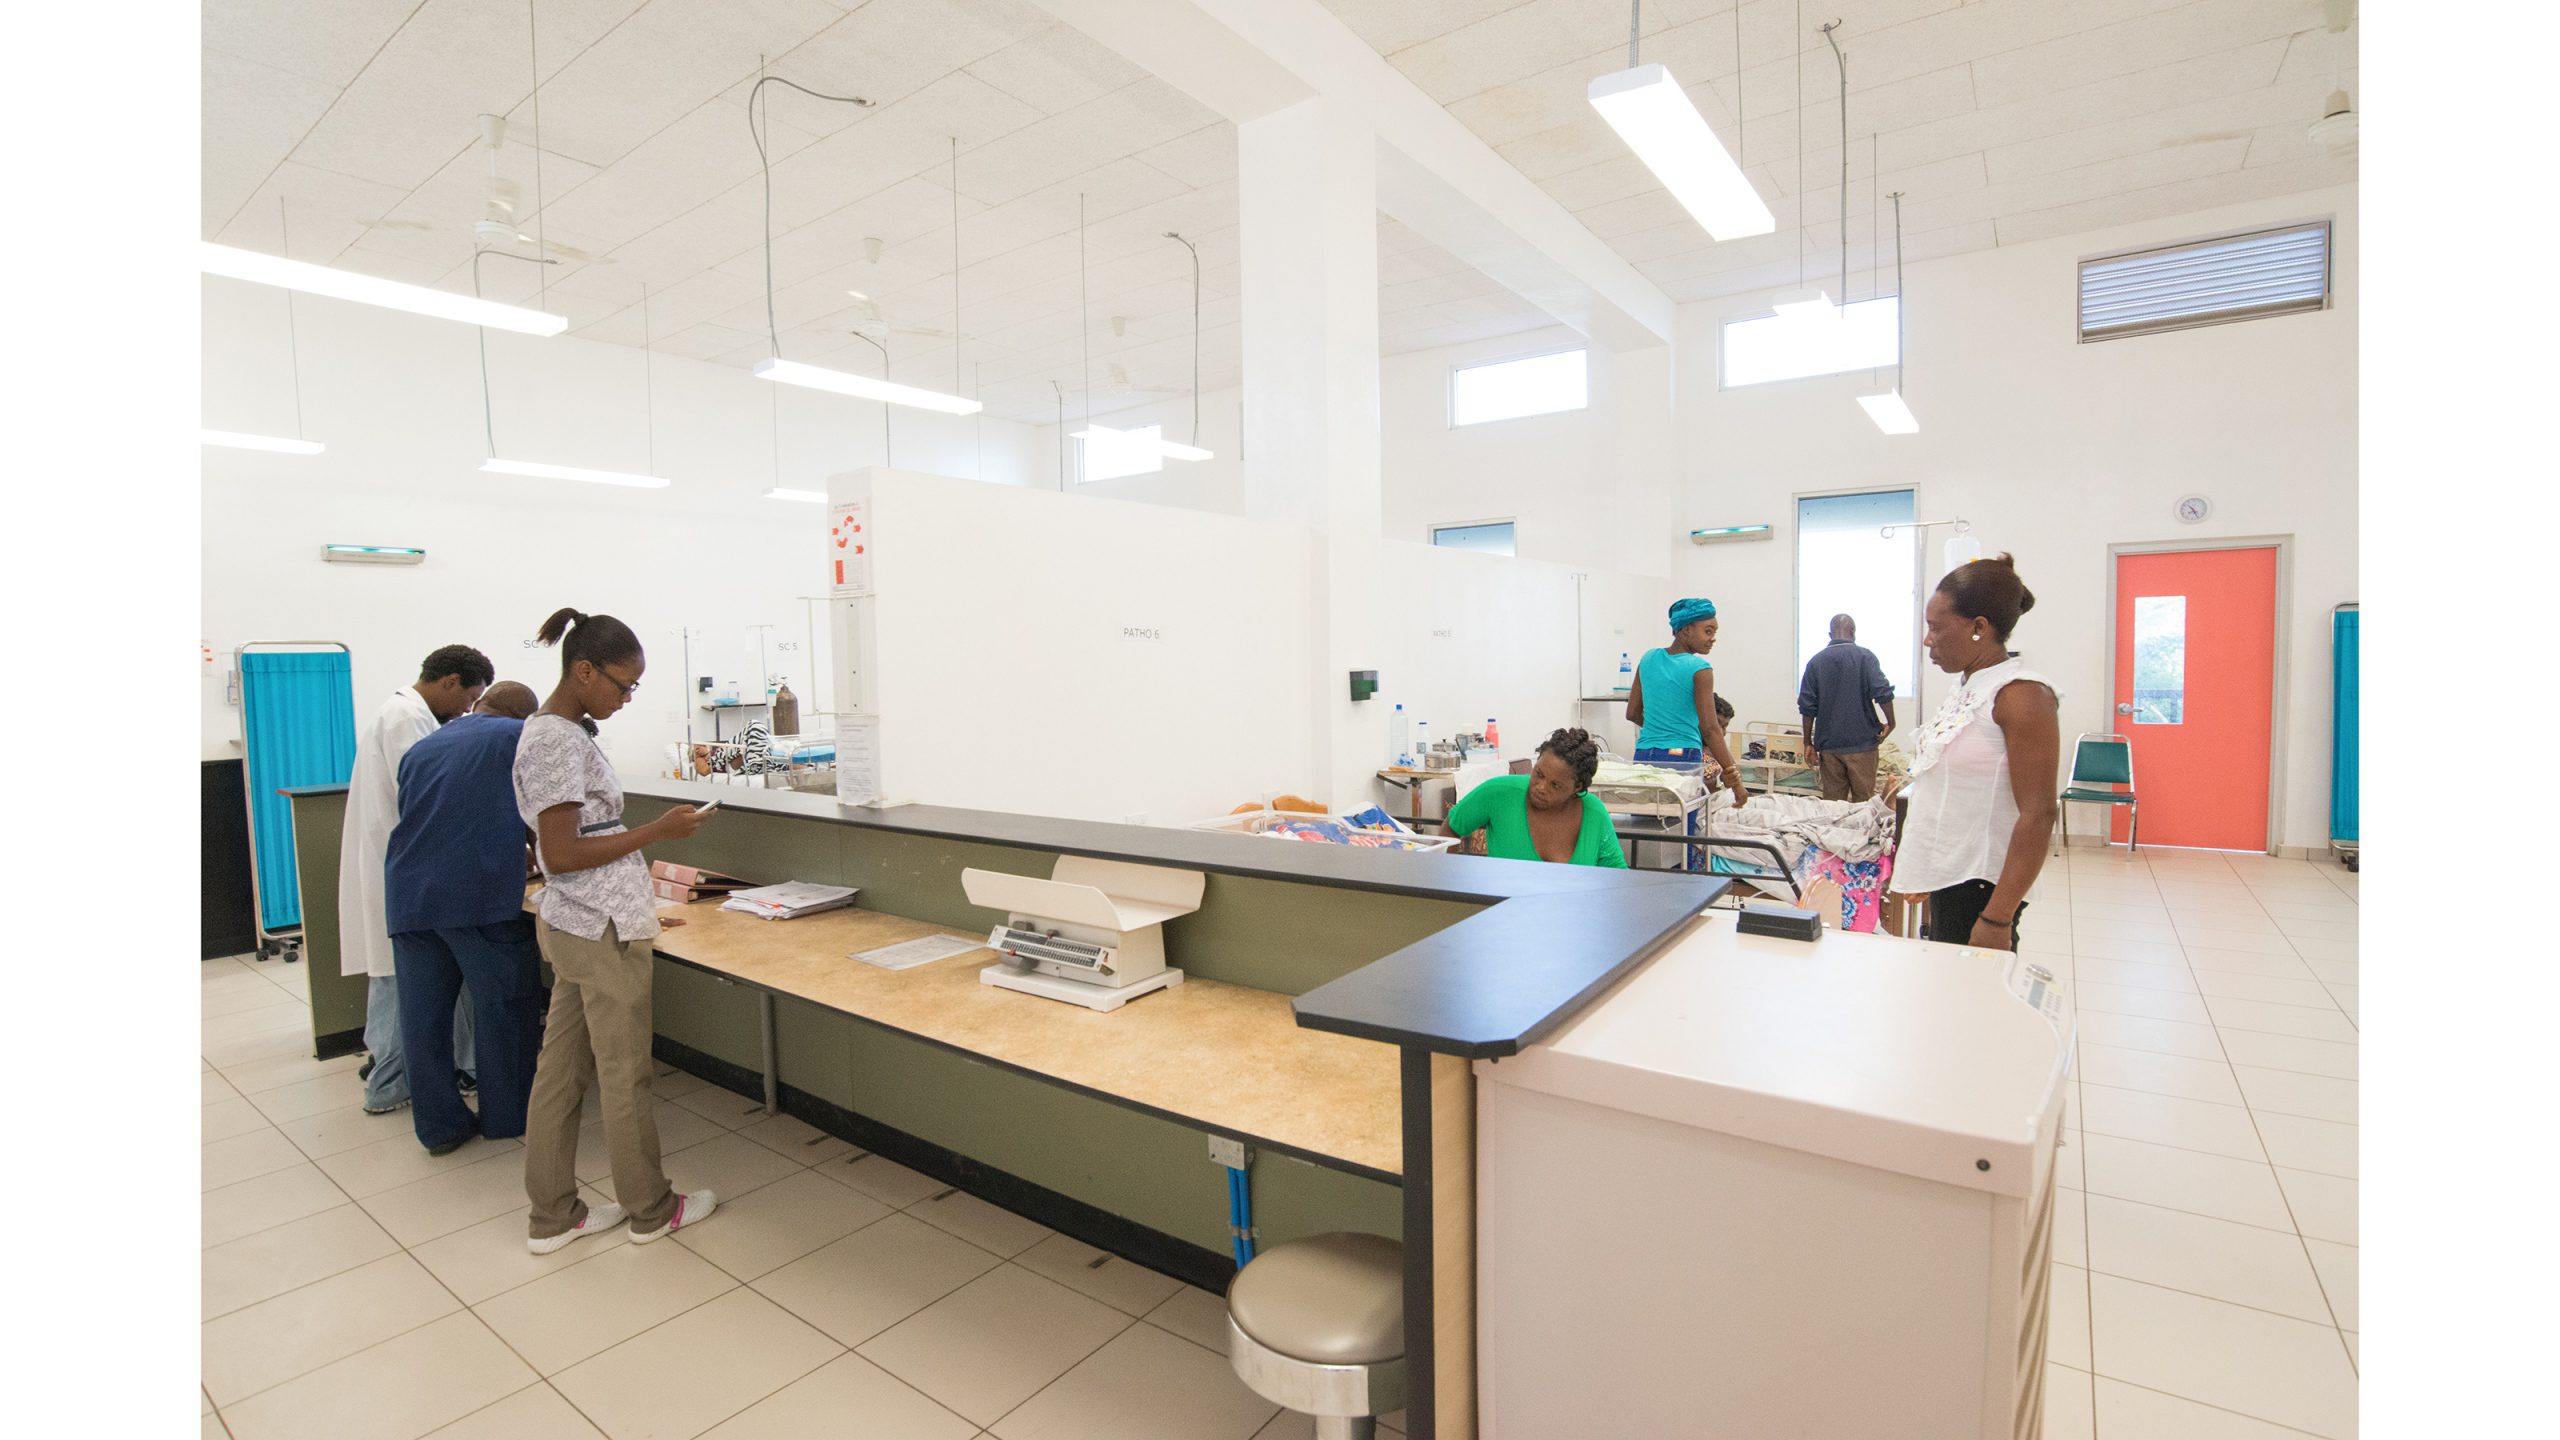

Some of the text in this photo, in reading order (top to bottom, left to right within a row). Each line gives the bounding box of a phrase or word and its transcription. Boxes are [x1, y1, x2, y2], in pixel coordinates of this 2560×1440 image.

[1123, 627, 1160, 640] PATHO 6
[523, 639, 539, 649] SC
[778, 642, 798, 651] SC 5
